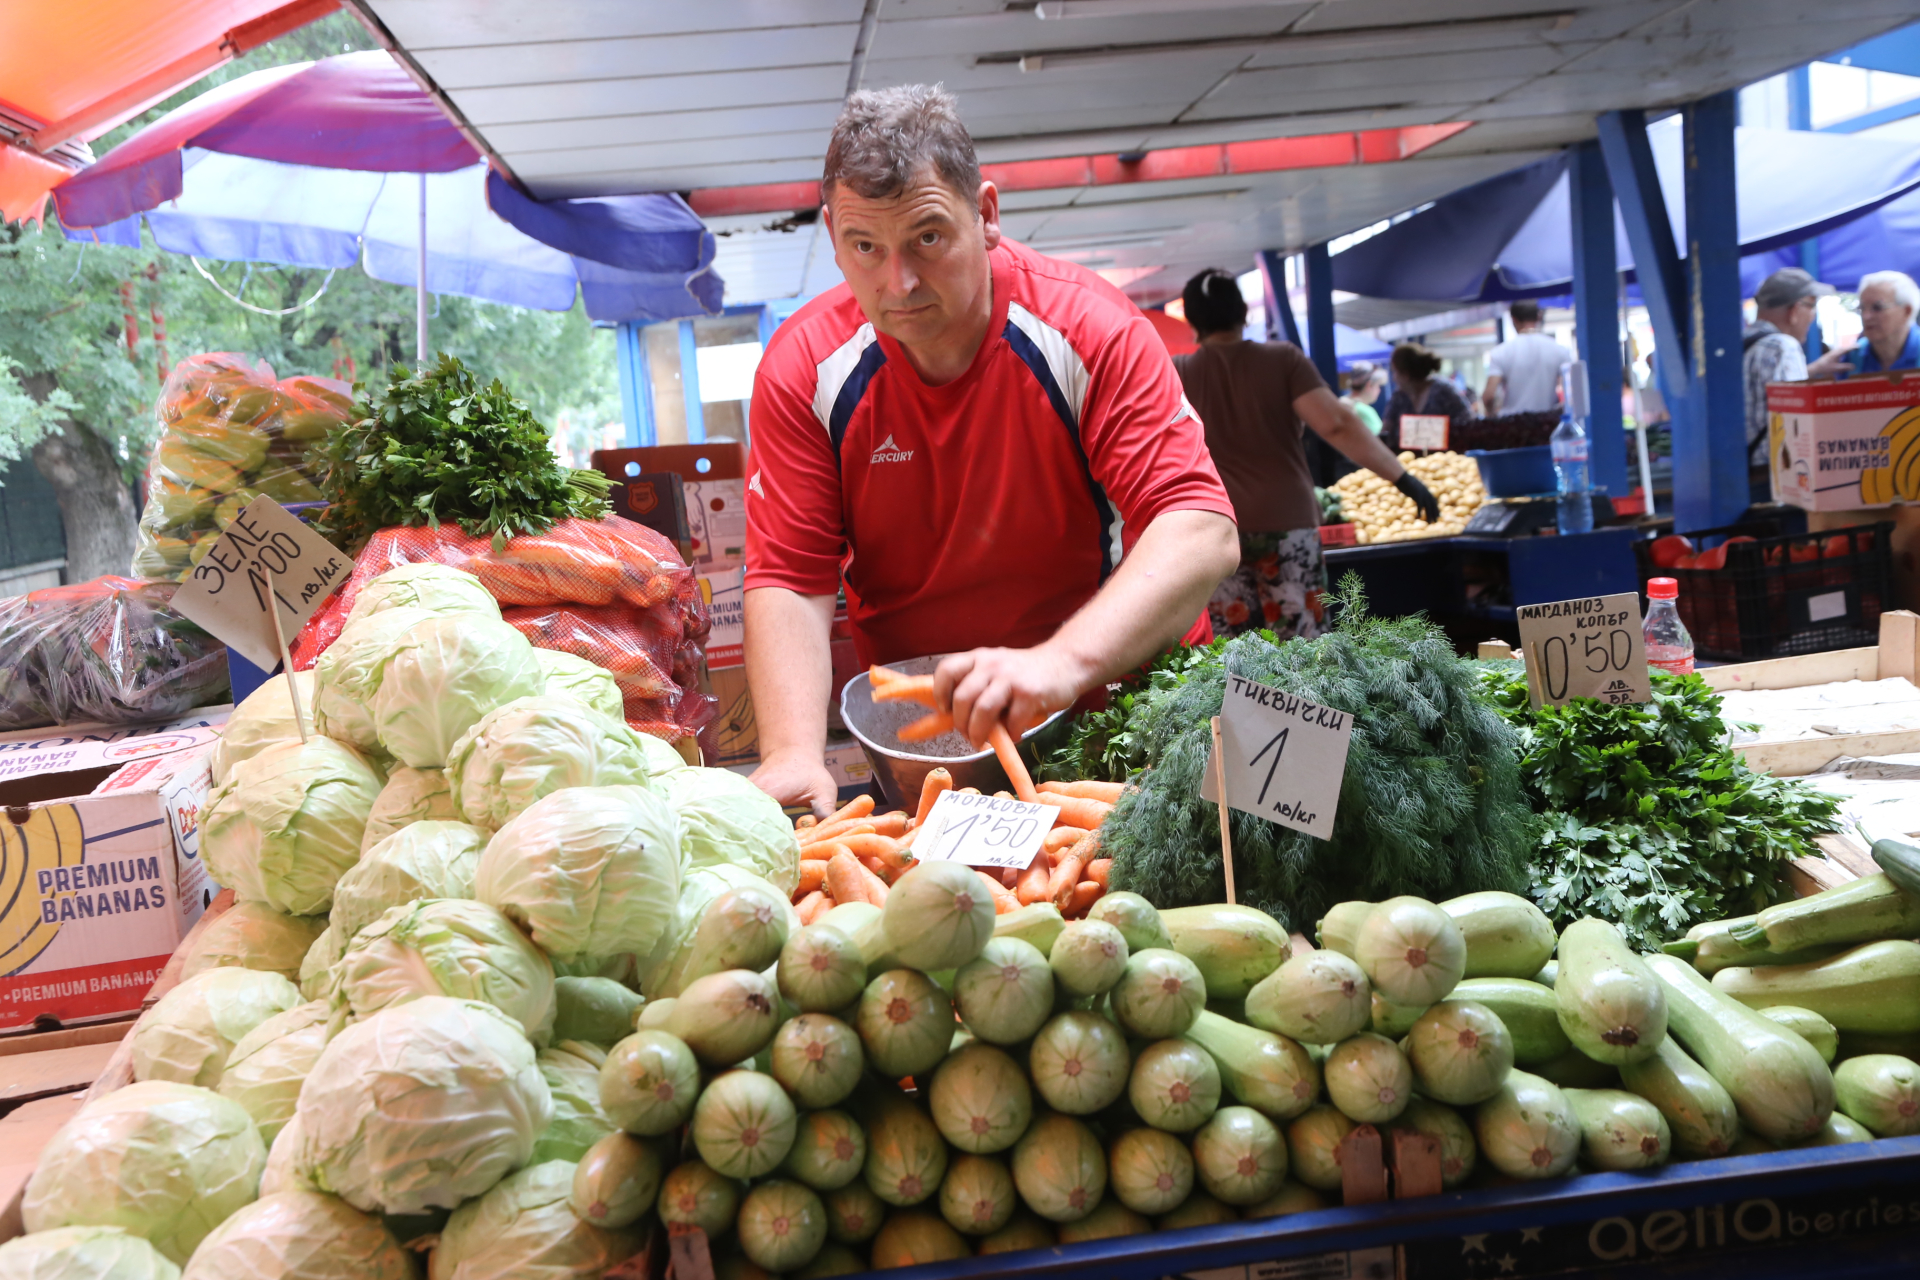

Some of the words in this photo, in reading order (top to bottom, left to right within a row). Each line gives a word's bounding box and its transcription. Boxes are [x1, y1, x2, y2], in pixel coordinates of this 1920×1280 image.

[1818, 435, 1890, 455] BANANAS
[870, 450, 914, 464] ERCURY
[1819, 454, 1890, 471] PREMIUM
[194, 511, 270, 594] ЗЕЛЕ
[707, 601, 742, 614] EMIUM
[1521, 598, 1604, 619] МАГДАНОЗ
[711, 613, 744, 626] NANAS
[1576, 611, 1629, 629] КОПЪР
[1232, 678, 1344, 730] ТИКВИЧКИ
[1249, 727, 1289, 804] 1
[944, 793, 1043, 815] МОРКОВИ
[38, 856, 160, 894] PREMIUM
[41, 885, 166, 924] BANANAS
[12, 979, 87, 1003] PREMIUM
[1788, 1196, 1920, 1236] berries
